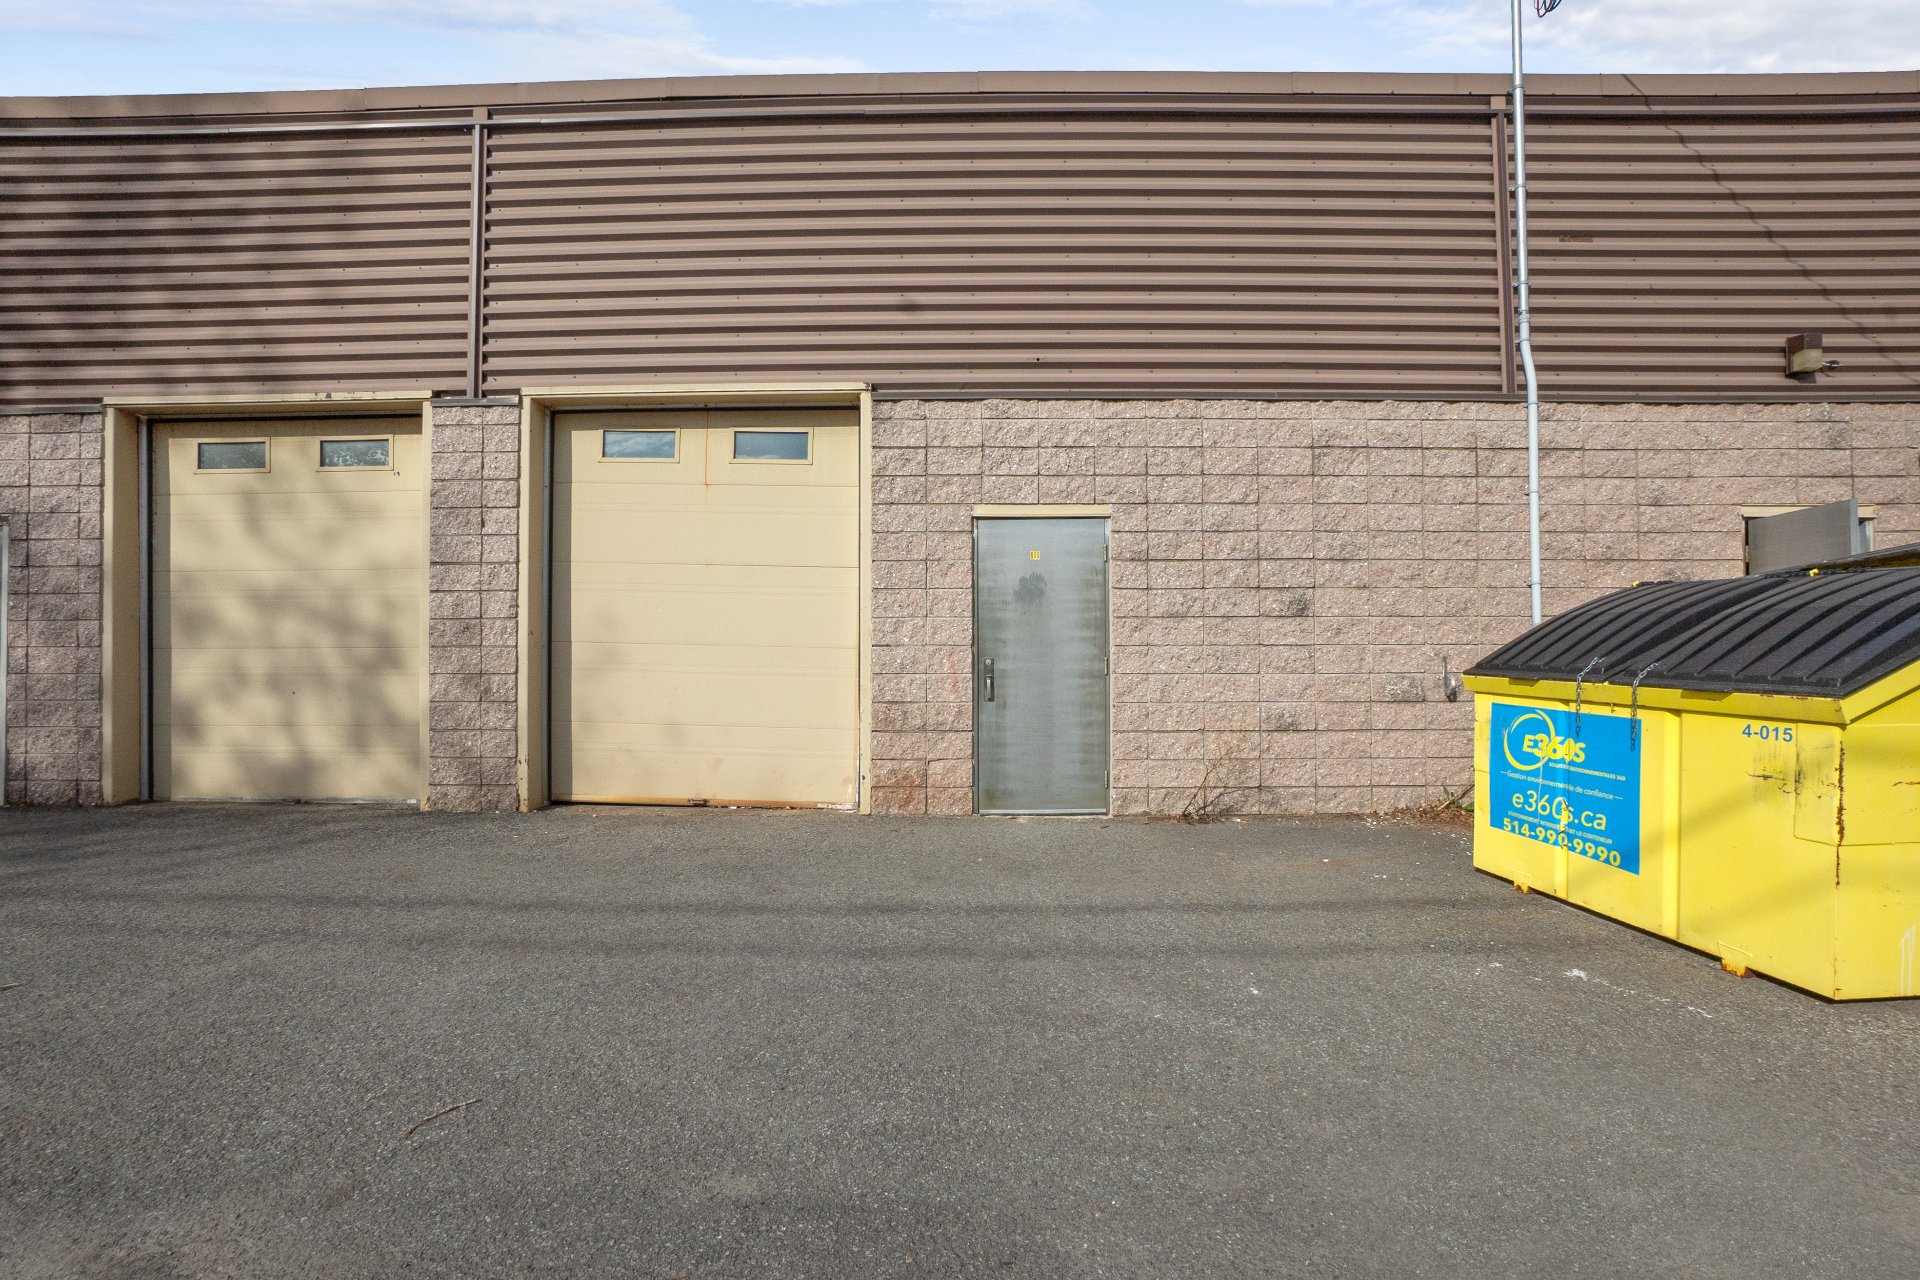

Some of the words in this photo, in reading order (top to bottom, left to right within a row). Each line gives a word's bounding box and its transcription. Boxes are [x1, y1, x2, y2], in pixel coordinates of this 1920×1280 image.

[1522, 733, 1586, 763] E360S
[1742, 724, 1793, 742] 4-015
[1584, 789, 1614, 800] confiance
[1512, 790, 1607, 831] e360s.ca
[1503, 817, 1621, 867] 514-990-9990
